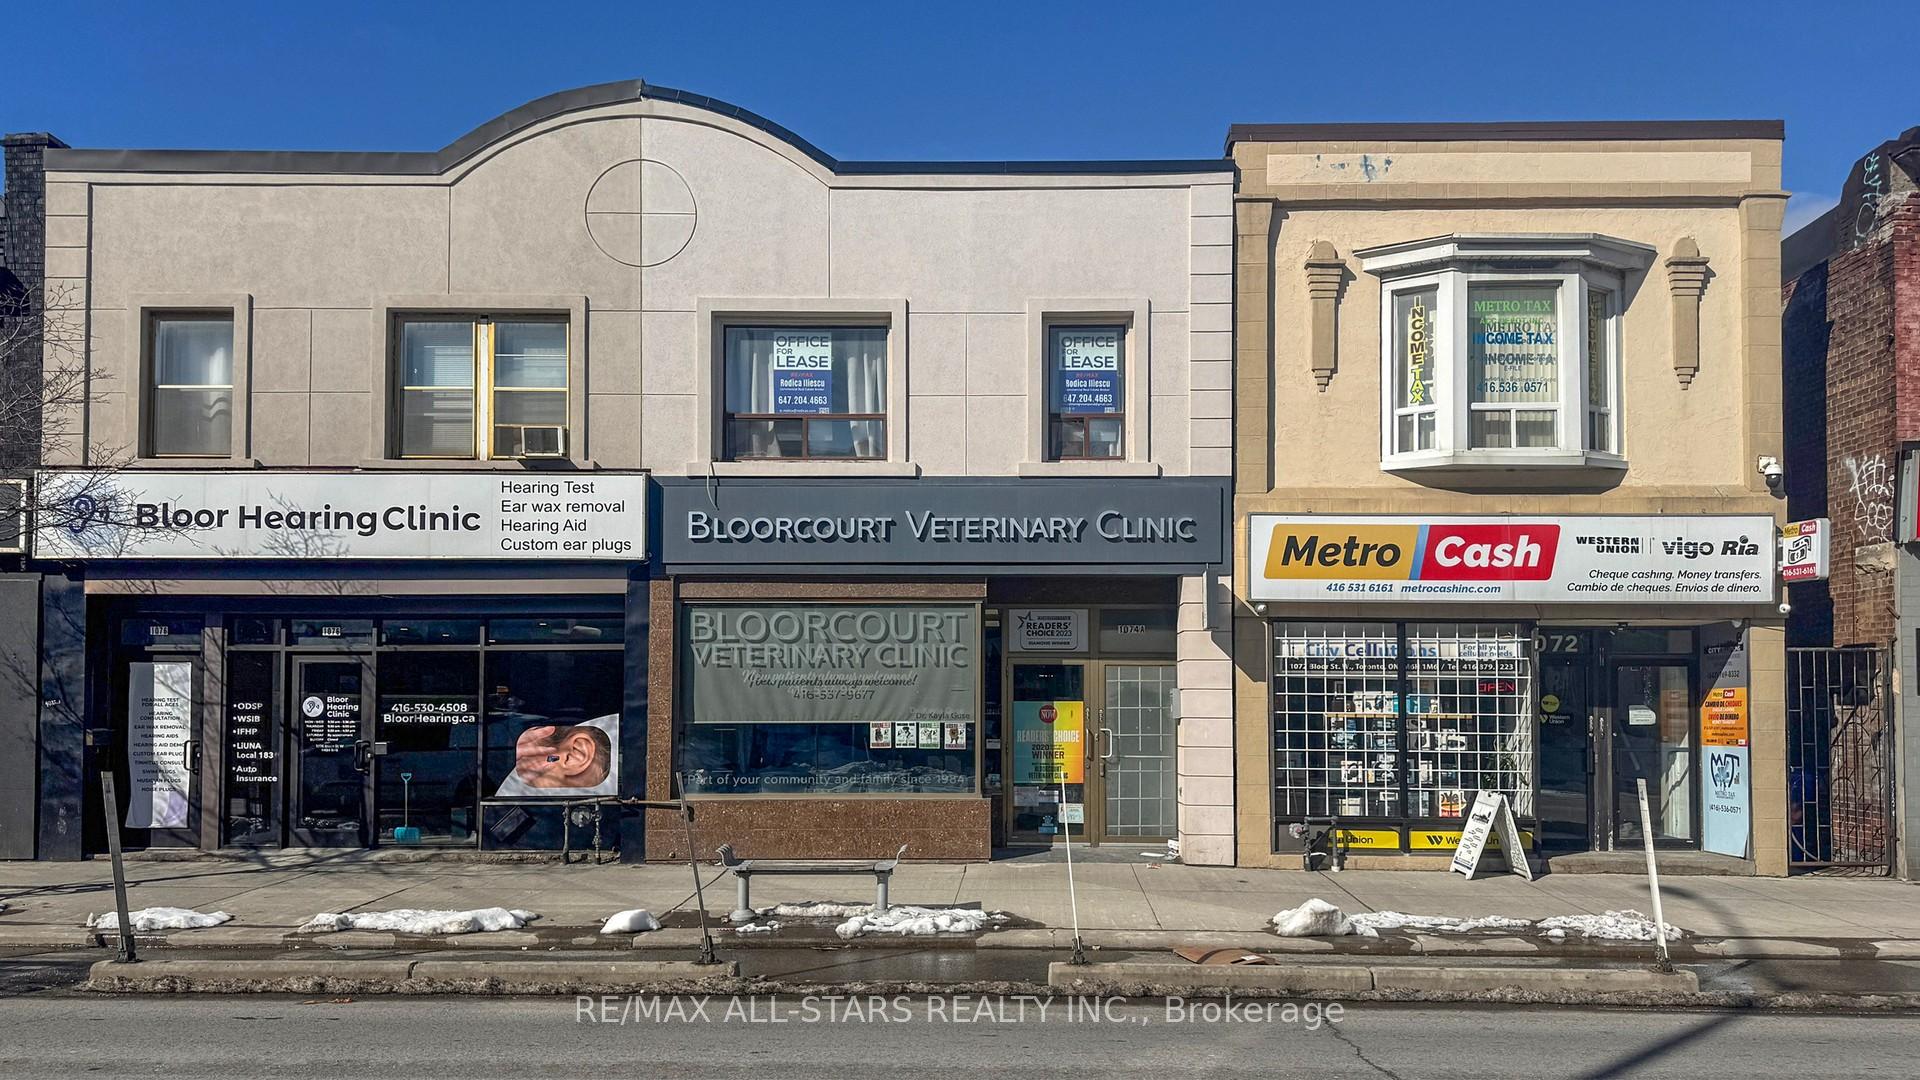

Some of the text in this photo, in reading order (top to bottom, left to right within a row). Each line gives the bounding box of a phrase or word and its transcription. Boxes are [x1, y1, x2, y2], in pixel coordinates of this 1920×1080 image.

[1474, 301, 1552, 312] METRO TAX
[776, 336, 829, 347] OFFICE
[1061, 336, 1114, 347] OFFICE
[1473, 333, 1553, 344] INCOME TAX
[777, 356, 828, 367] LEASE
[1062, 356, 1114, 368] LEASE
[778, 396, 827, 404] 647.204.4663
[501, 481, 594, 496] Hearing Test
[501, 500, 625, 513] Ear wax removal
[136, 503, 481, 536] Bloor Hearing Clinic
[501, 519, 587, 534] Hearing Aid
[1801, 522, 1816, 533] Cash
[501, 538, 631, 553] Custom ear plugs
[1576, 536, 1639, 545] WESTERN
[1721, 535, 1759, 556] Ria
[1281, 534, 1542, 568] Metro Cash
[1597, 545, 1639, 553] UNION
[1662, 537, 1714, 559] vigo
[1588, 570, 1762, 581] Cheque cashing. Money transfers.
[1783, 567, 1816, 577] 416-531-6161
[1326, 583, 1393, 592] 416 531 6161
[1401, 584, 1501, 593] metrocashinc.com
[1567, 582, 1608, 592] Cambio
[1611, 582, 1624, 592] de
[1627, 582, 1672, 594] cheques.
[1711, 583, 1724, 592] de
[1727, 583, 1762, 593] dinero.
[690, 611, 969, 644] BLOORCOURT
[690, 643, 969, 668] VETERINARY CLINIC
[327, 703, 359, 711] Hearing
[391, 704, 468, 712] 416-530-4508
[384, 714, 475, 724] BloorHearing.ca
[1032, 751, 1064, 759] WINNER
[688, 774, 713, 784] Part
[717, 773, 729, 784] of
[733, 775, 761, 787] your
[764, 773, 830, 787] community
[835, 774, 856, 784] and
[861, 773, 897, 787] family
[901, 774, 931, 784] since
